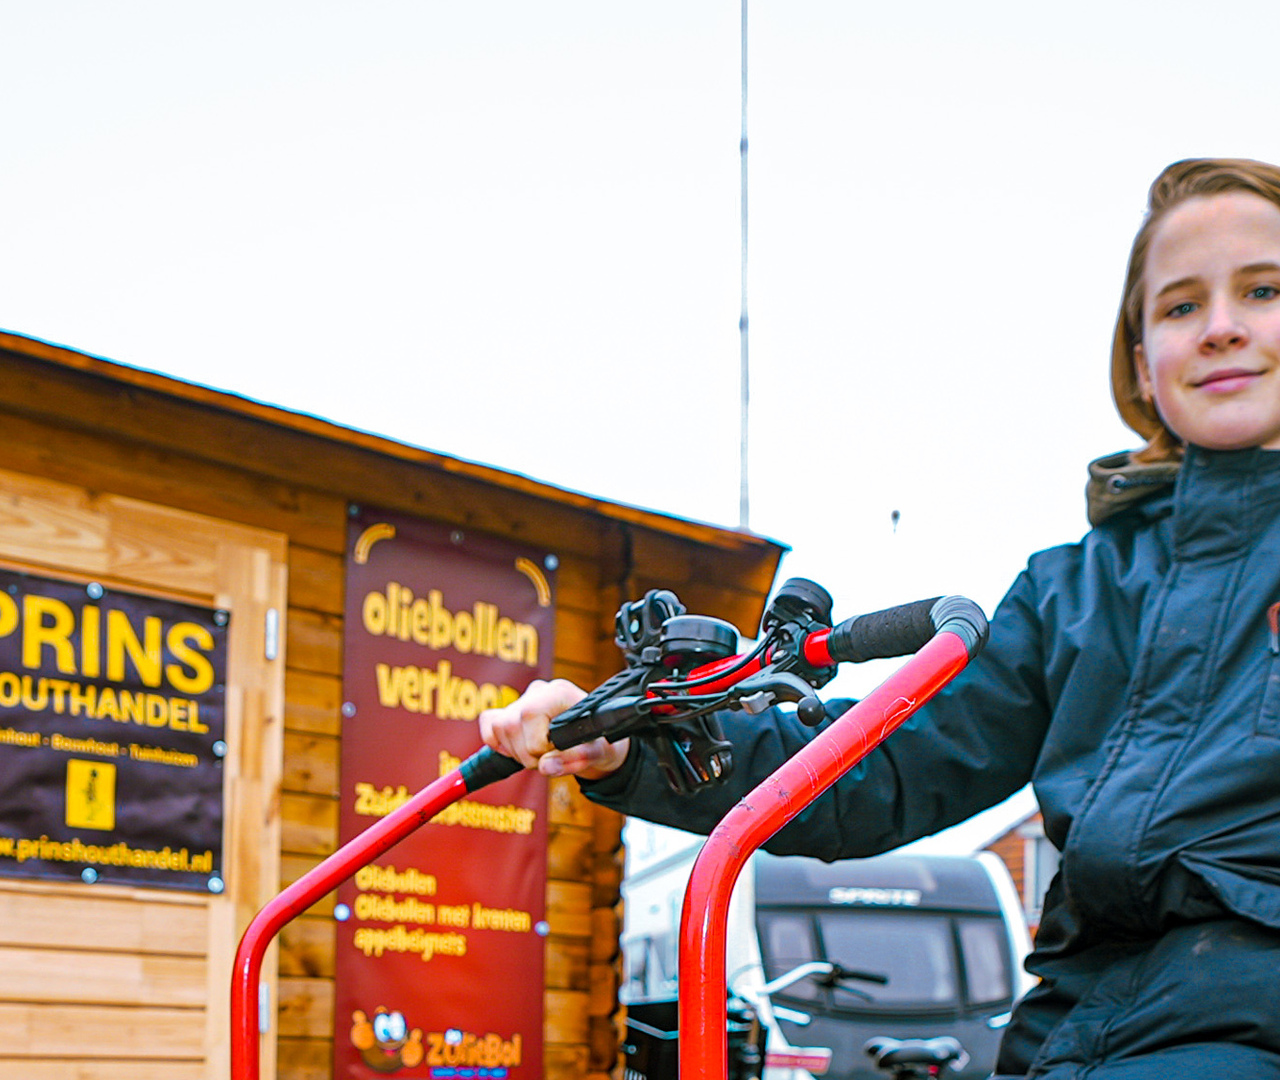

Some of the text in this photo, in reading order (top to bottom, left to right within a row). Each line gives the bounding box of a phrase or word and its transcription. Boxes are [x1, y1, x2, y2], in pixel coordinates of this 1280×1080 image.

[362, 581, 539, 667] oliebollen
[355, 864, 437, 896] Oliebollen
[355, 894, 531, 933] Oliebollen met krenten
